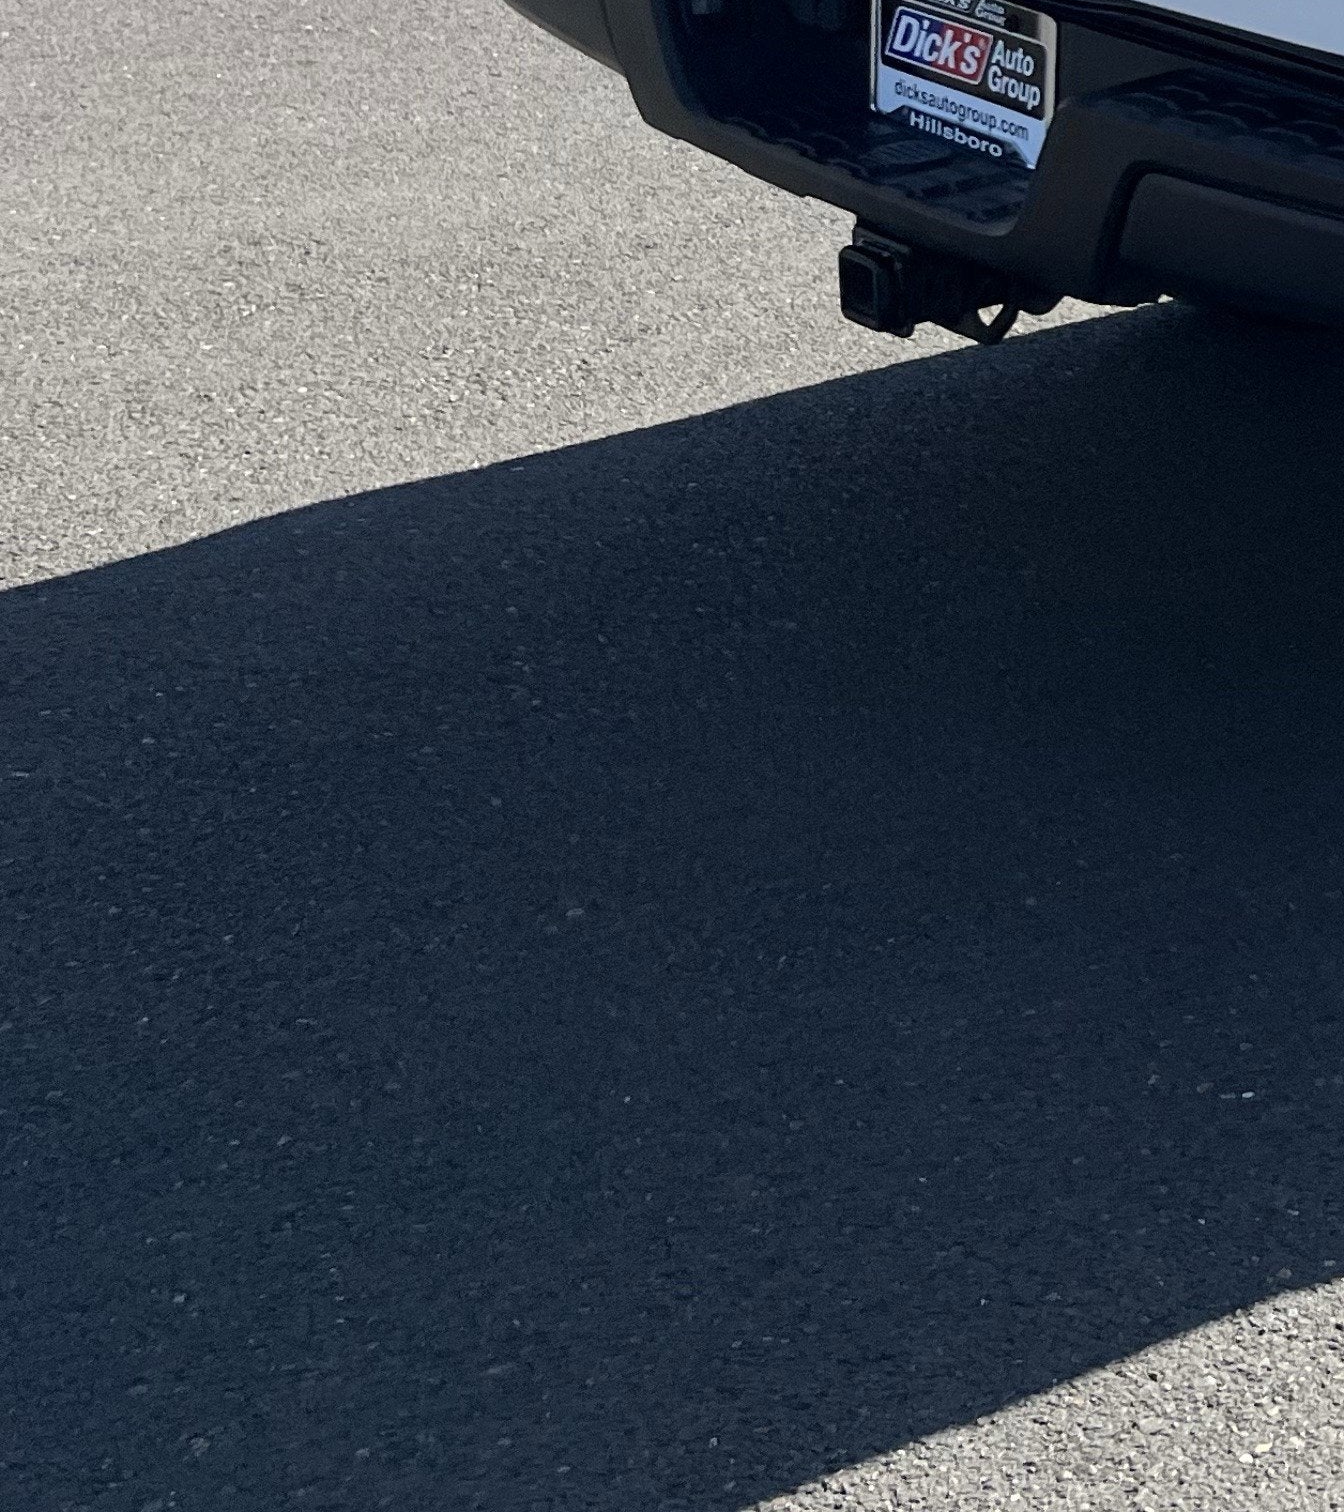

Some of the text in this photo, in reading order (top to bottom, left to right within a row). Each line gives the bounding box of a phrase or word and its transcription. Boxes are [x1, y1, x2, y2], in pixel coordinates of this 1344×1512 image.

[892, 13, 981, 76] Dick's
[991, 40, 1036, 77] Auto
[894, 78, 1030, 141] dicksautogroup.com
[987, 66, 1041, 110] Group
[909, 110, 1003, 158] Hillsboro
